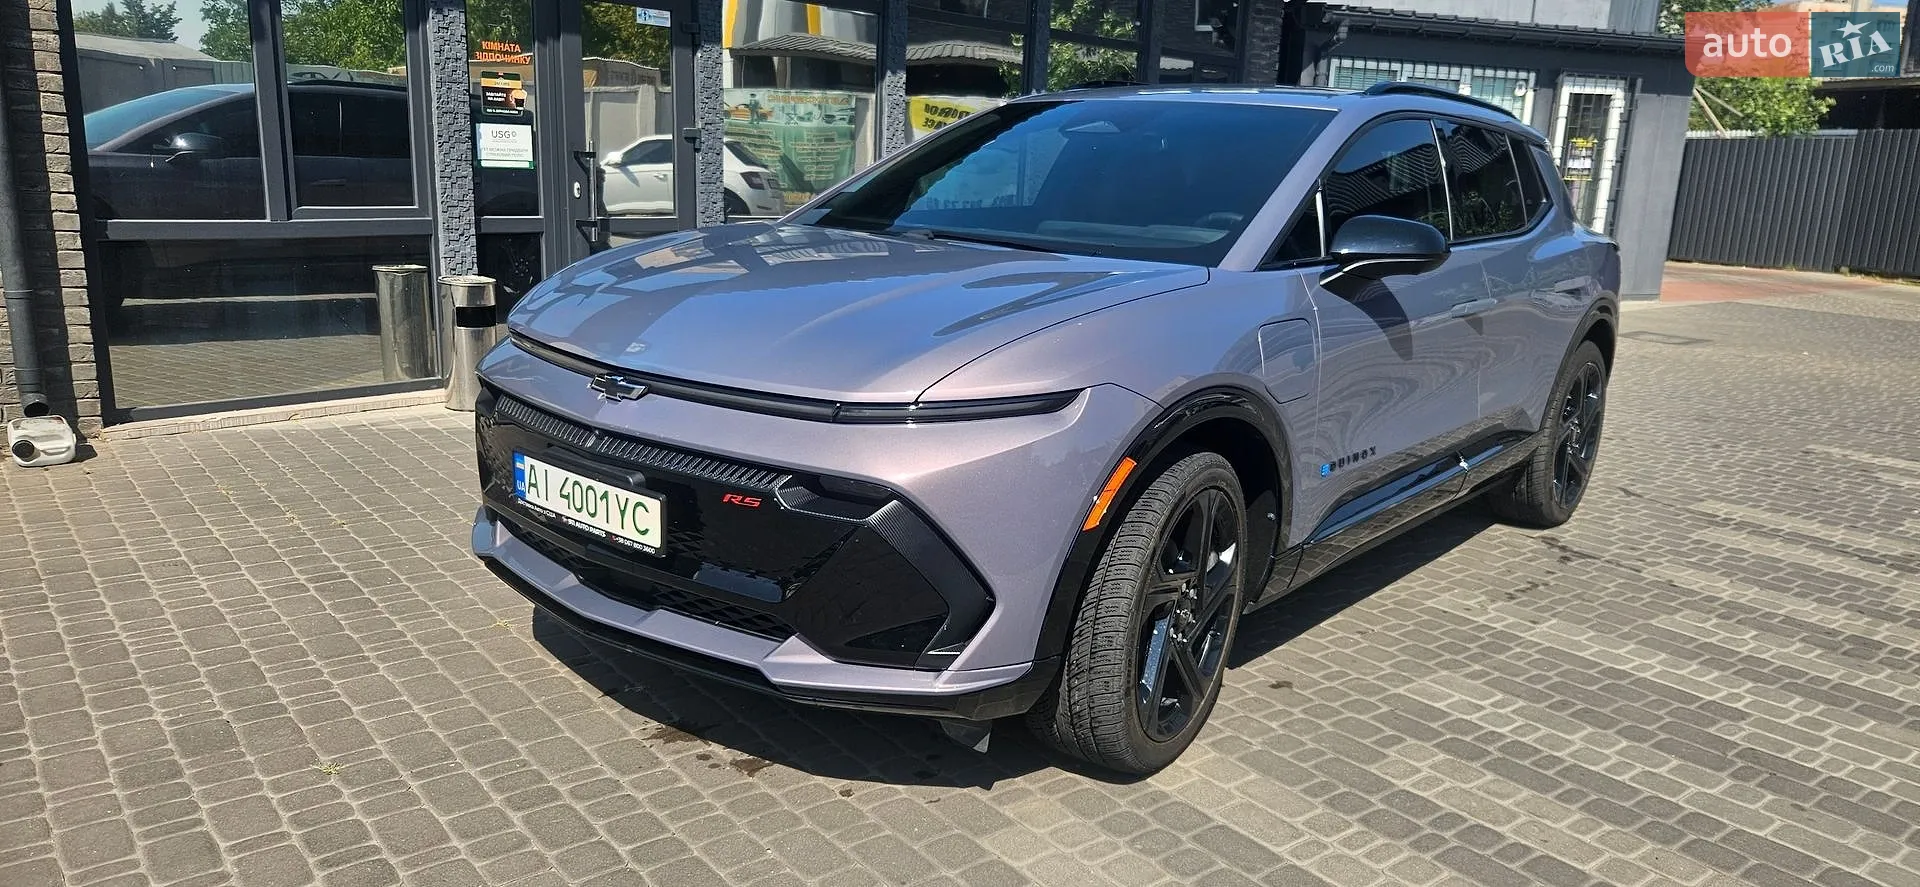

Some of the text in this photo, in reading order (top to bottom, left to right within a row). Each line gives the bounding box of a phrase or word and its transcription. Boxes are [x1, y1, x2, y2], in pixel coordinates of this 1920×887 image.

[481, 41, 521, 53] КІМНАТА
[1320, 446, 1377, 477] EQUINOX
[516, 480, 526, 492] UA
[527, 464, 549, 501] AI
[722, 493, 762, 508] RS
